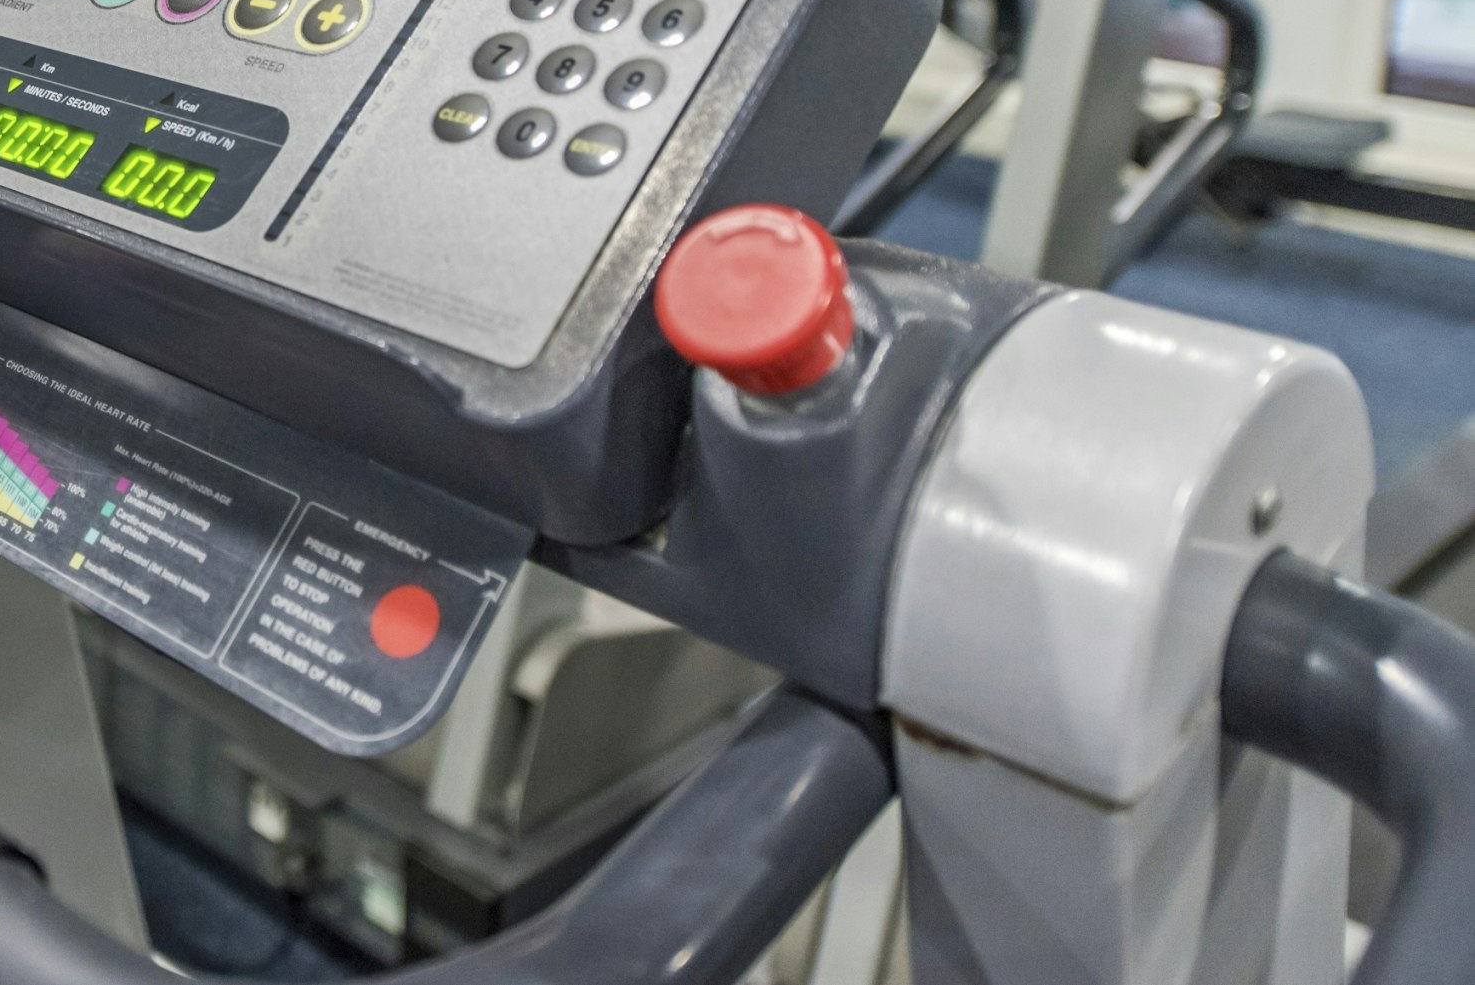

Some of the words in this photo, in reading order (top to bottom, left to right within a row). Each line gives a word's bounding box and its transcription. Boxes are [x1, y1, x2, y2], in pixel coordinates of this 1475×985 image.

[661, 8, 684, 30] 6
[243, 55, 285, 74] SPEED
[490, 44, 514, 65] 7
[40, 62, 56, 74] Km
[554, 58, 576, 78] 8
[623, 71, 645, 93] 9
[176, 99, 200, 113] Kcal
[438, 107, 478, 126] CLEA
[161, 120, 196, 138] SPEED
[516, 121, 536, 142] 0
[5, 359, 49, 386] CHOOSING
[49, 379, 68, 394] THE
[66, 387, 92, 406] IDEAL
[94, 400, 126, 420] HEART
[125, 414, 152, 433] RATE
[67, 482, 86, 498] 100%
[10, 522, 22, 535] 70
[24, 529, 37, 543] 75
[354, 520, 431, 562] EMERGENCY
[303, 536, 341, 562] PRESS
[341, 553, 366, 574] THE
[292, 554, 317, 575] RED
[316, 567, 364, 598] BUTTON
[282, 573, 299, 591] TO
[297, 582, 330, 605] STOP
[270, 593, 336, 635] OPERATION
[259, 613, 274, 629] IN
[272, 619, 297, 641] THE
[294, 631, 328, 658] CASE
[326, 647, 346, 665] OF
[308, 664, 327, 682] OF
